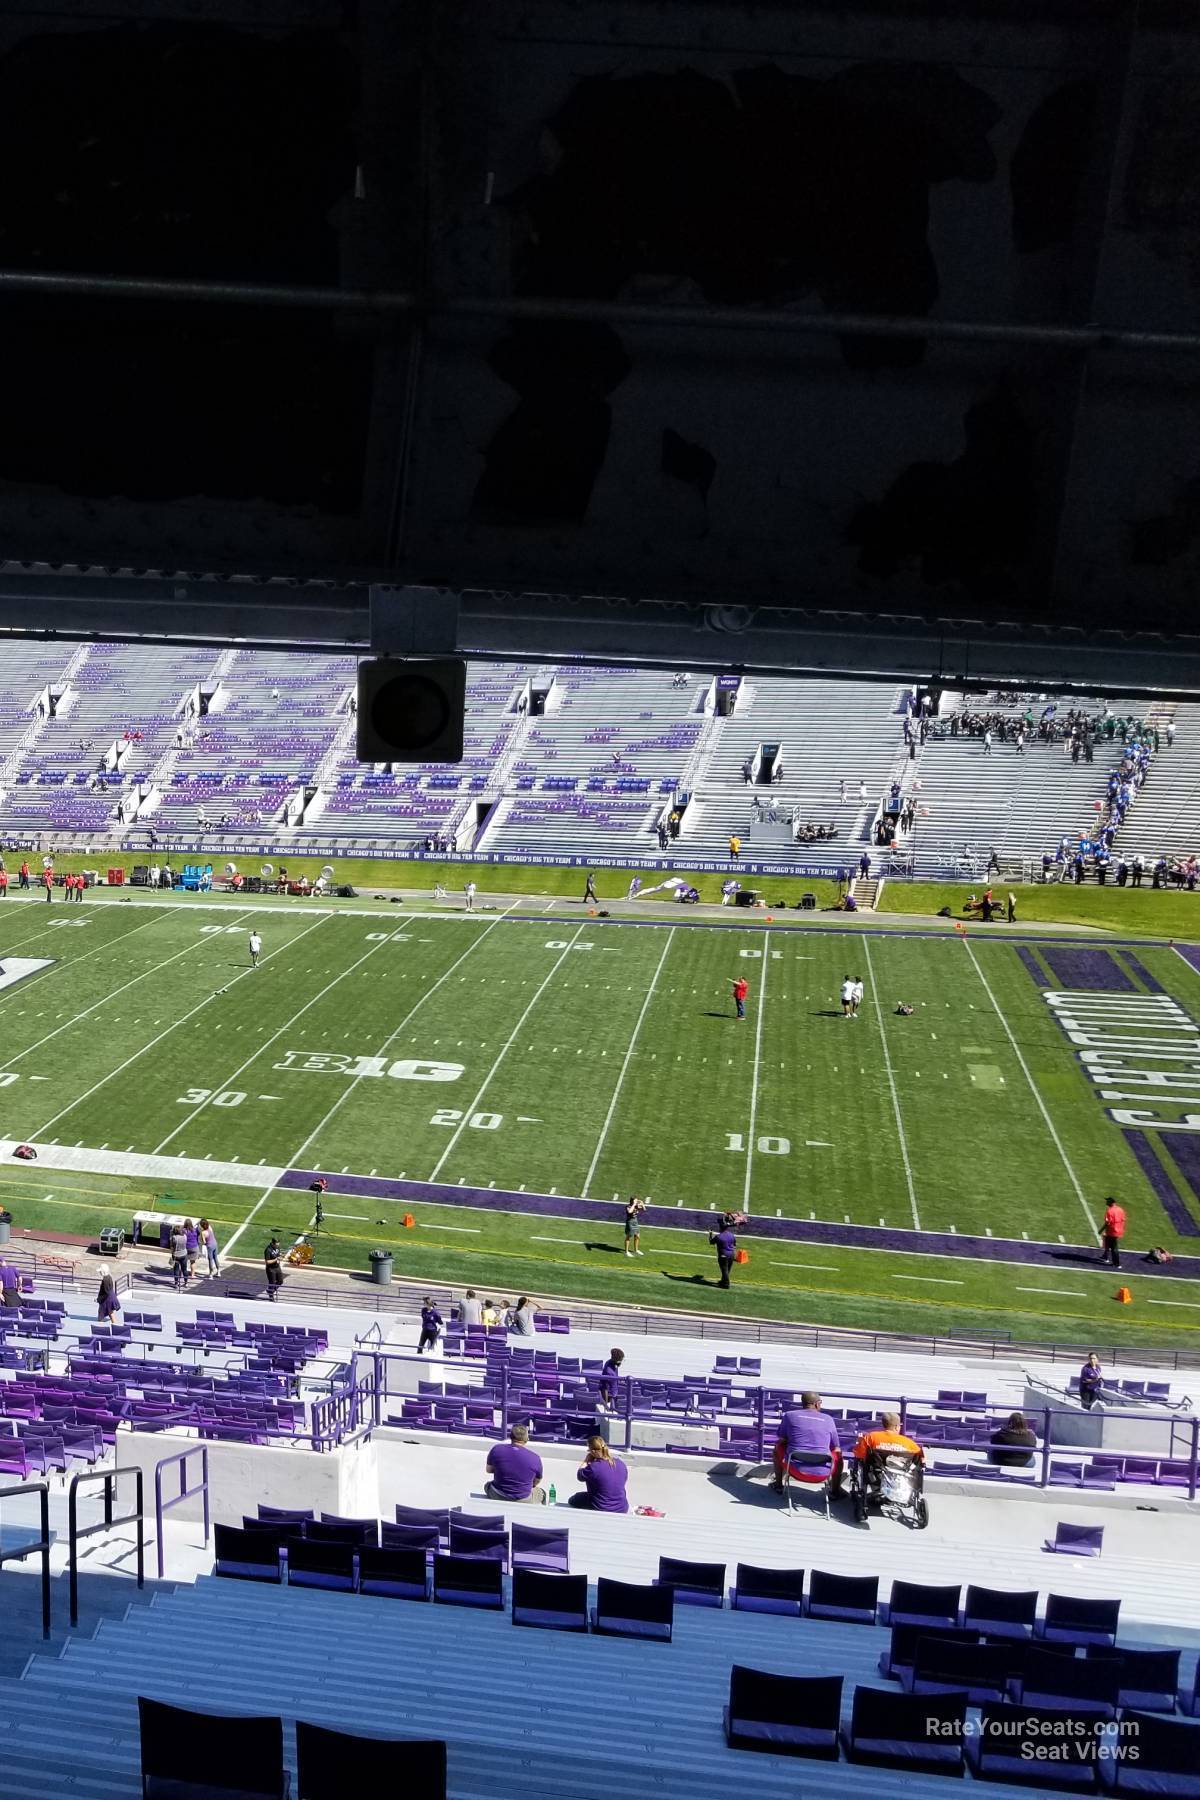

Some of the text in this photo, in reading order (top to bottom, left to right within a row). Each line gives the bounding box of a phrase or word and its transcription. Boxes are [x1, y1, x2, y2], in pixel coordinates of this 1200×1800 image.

[576, 857, 582, 865] N
[673, 861, 703, 870] CHICAGO'S
[704, 862, 714, 870] BIG
[729, 863, 746, 871] TEAM
[751, 864, 758, 872] N
[762, 865, 795, 873] CHICAGO'S
[795, 866, 806, 874] BIG
[820, 868, 838, 876] TEAM
[199, 925, 247, 934] 40
[364, 933, 414, 941] 30
[544, 940, 594, 950] 20
[176, 1088, 248, 1107] 30
[429, 1109, 504, 1130] 20
[724, 1133, 791, 1155] 10
